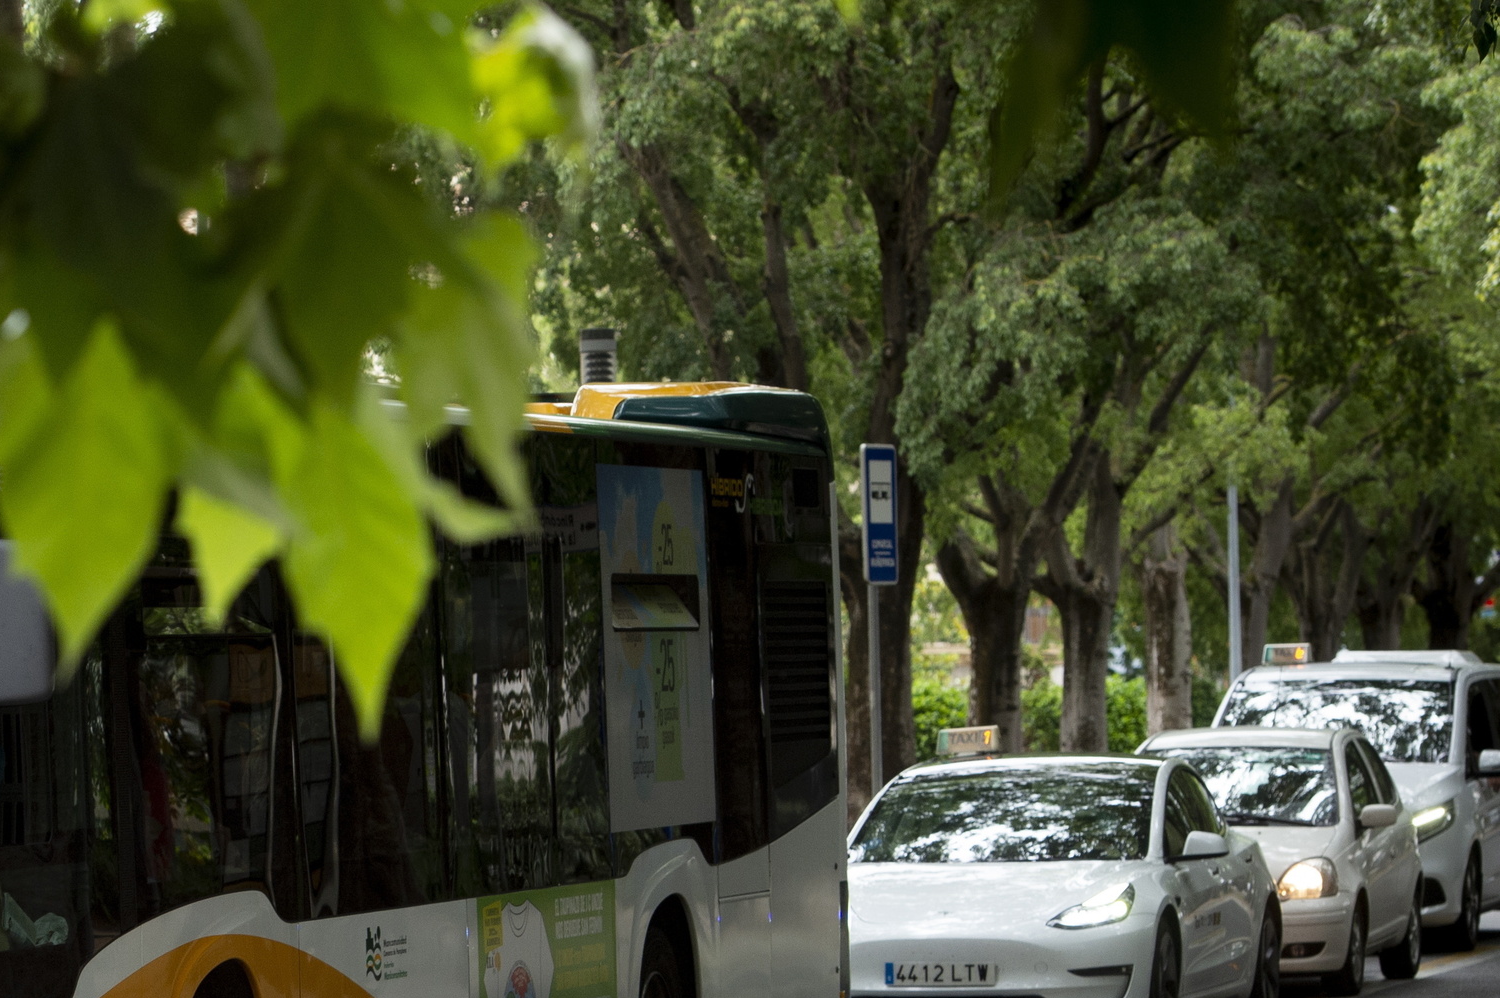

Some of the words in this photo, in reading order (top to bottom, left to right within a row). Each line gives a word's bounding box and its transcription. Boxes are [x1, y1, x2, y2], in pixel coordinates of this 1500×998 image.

[656, 638, 675, 692] -25
[896, 964, 944, 982] 4412
[951, 964, 988, 982] LTW
